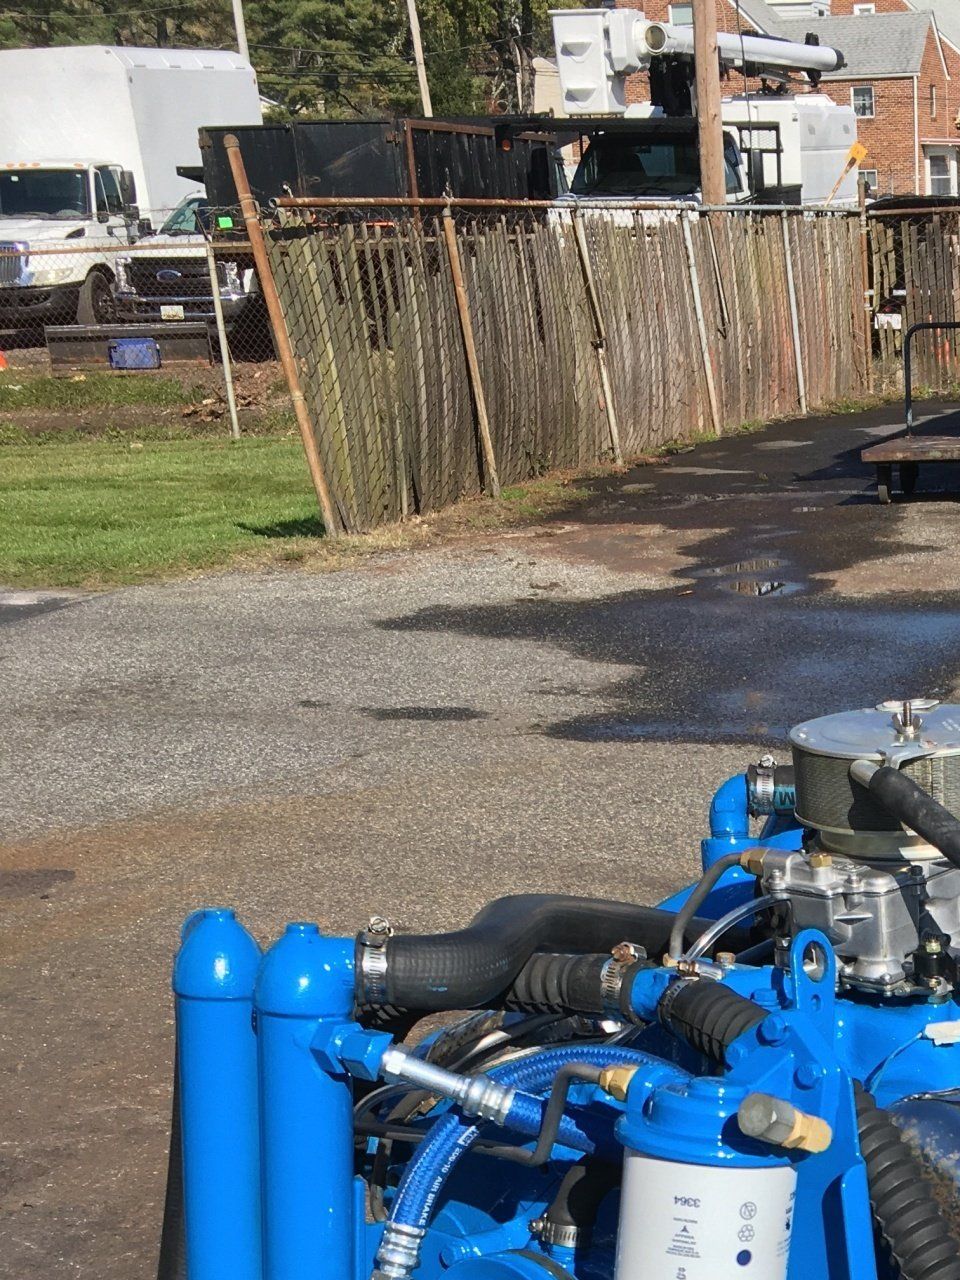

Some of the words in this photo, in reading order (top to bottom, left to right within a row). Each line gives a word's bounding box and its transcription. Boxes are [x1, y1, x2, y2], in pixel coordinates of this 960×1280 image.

[431, 1176, 443, 1192] AIR
[418, 1193, 436, 1226] BRAKE
[674, 1195, 701, 1208] 3364
